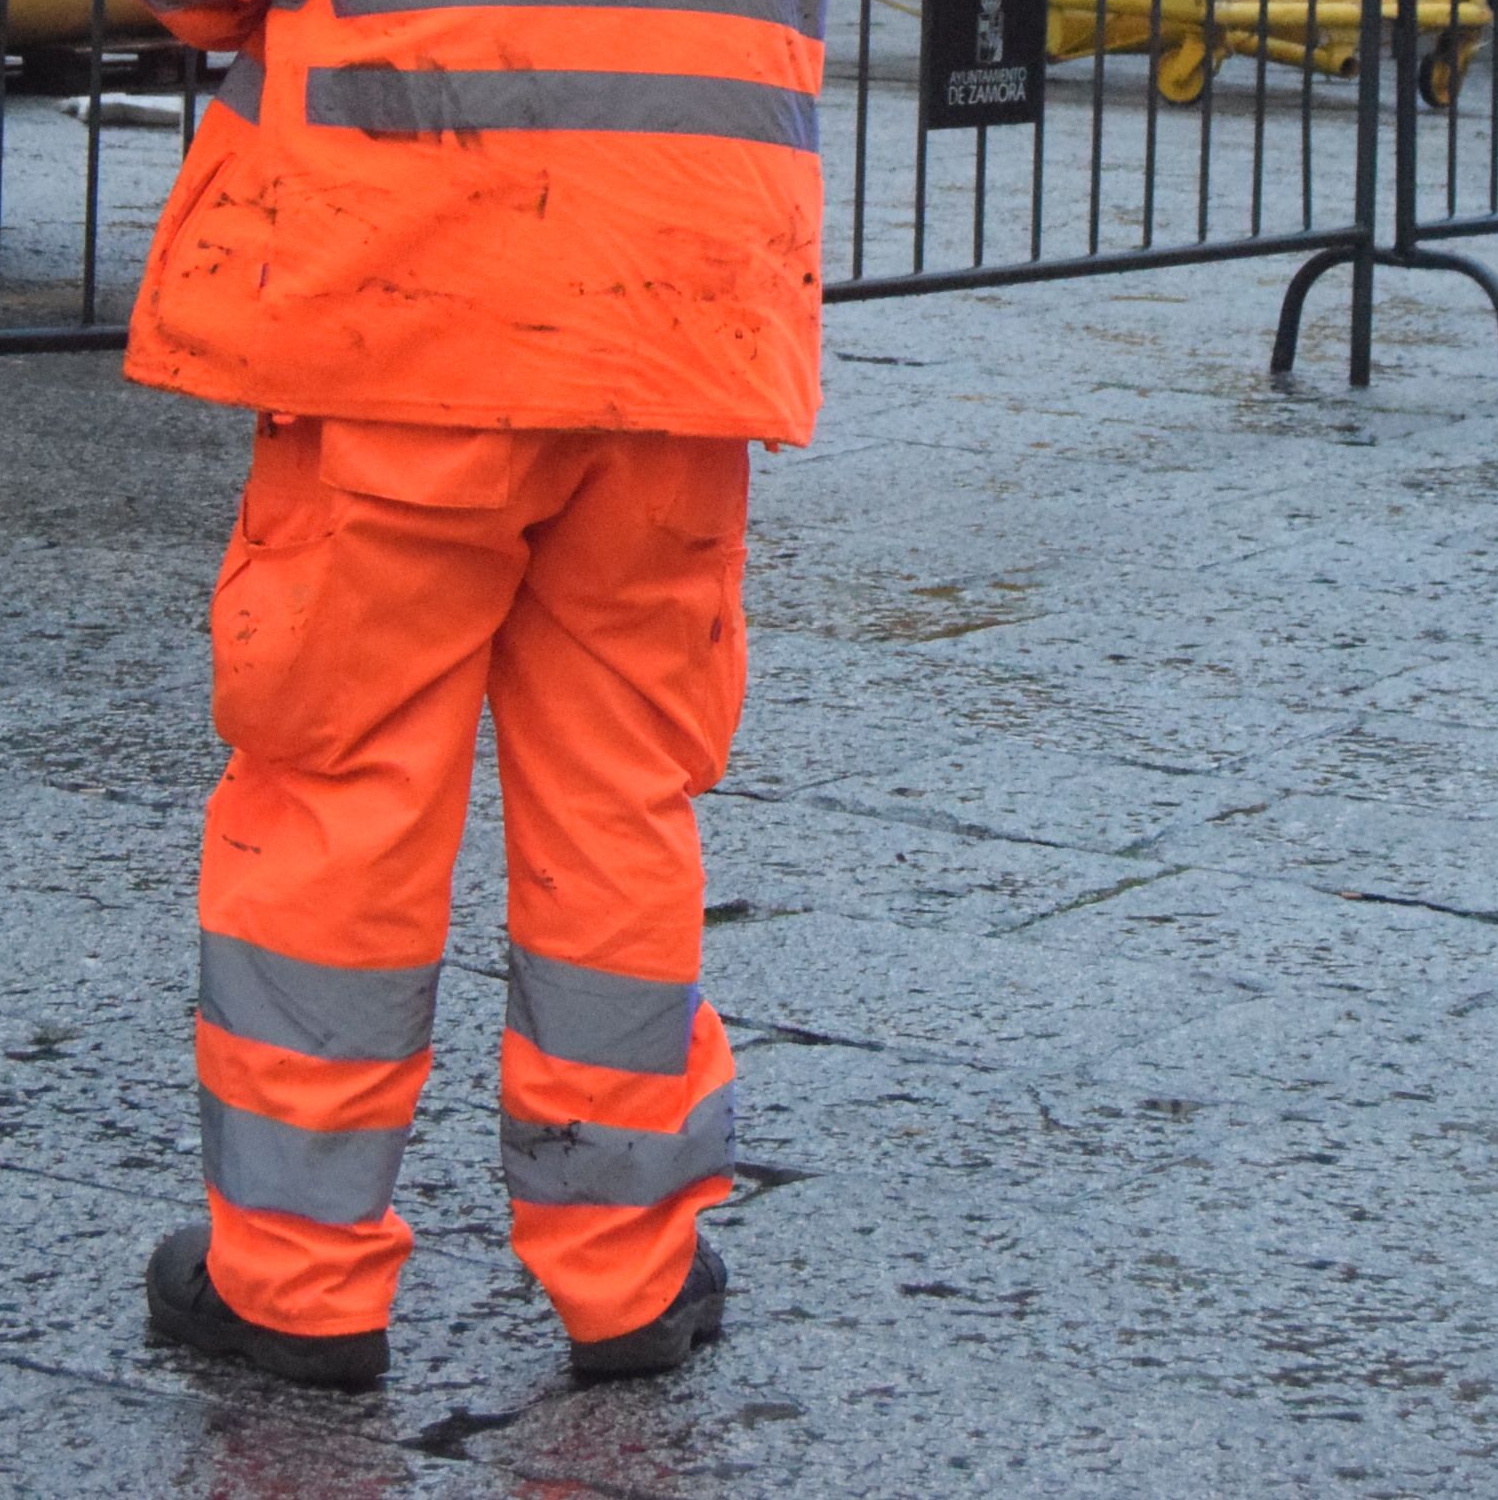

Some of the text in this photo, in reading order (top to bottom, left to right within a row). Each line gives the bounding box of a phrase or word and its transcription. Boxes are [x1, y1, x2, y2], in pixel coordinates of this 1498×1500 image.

[949, 66, 1028, 85] AYUNTAMIENTO
[948, 81, 1027, 105] DE ZAMORA
